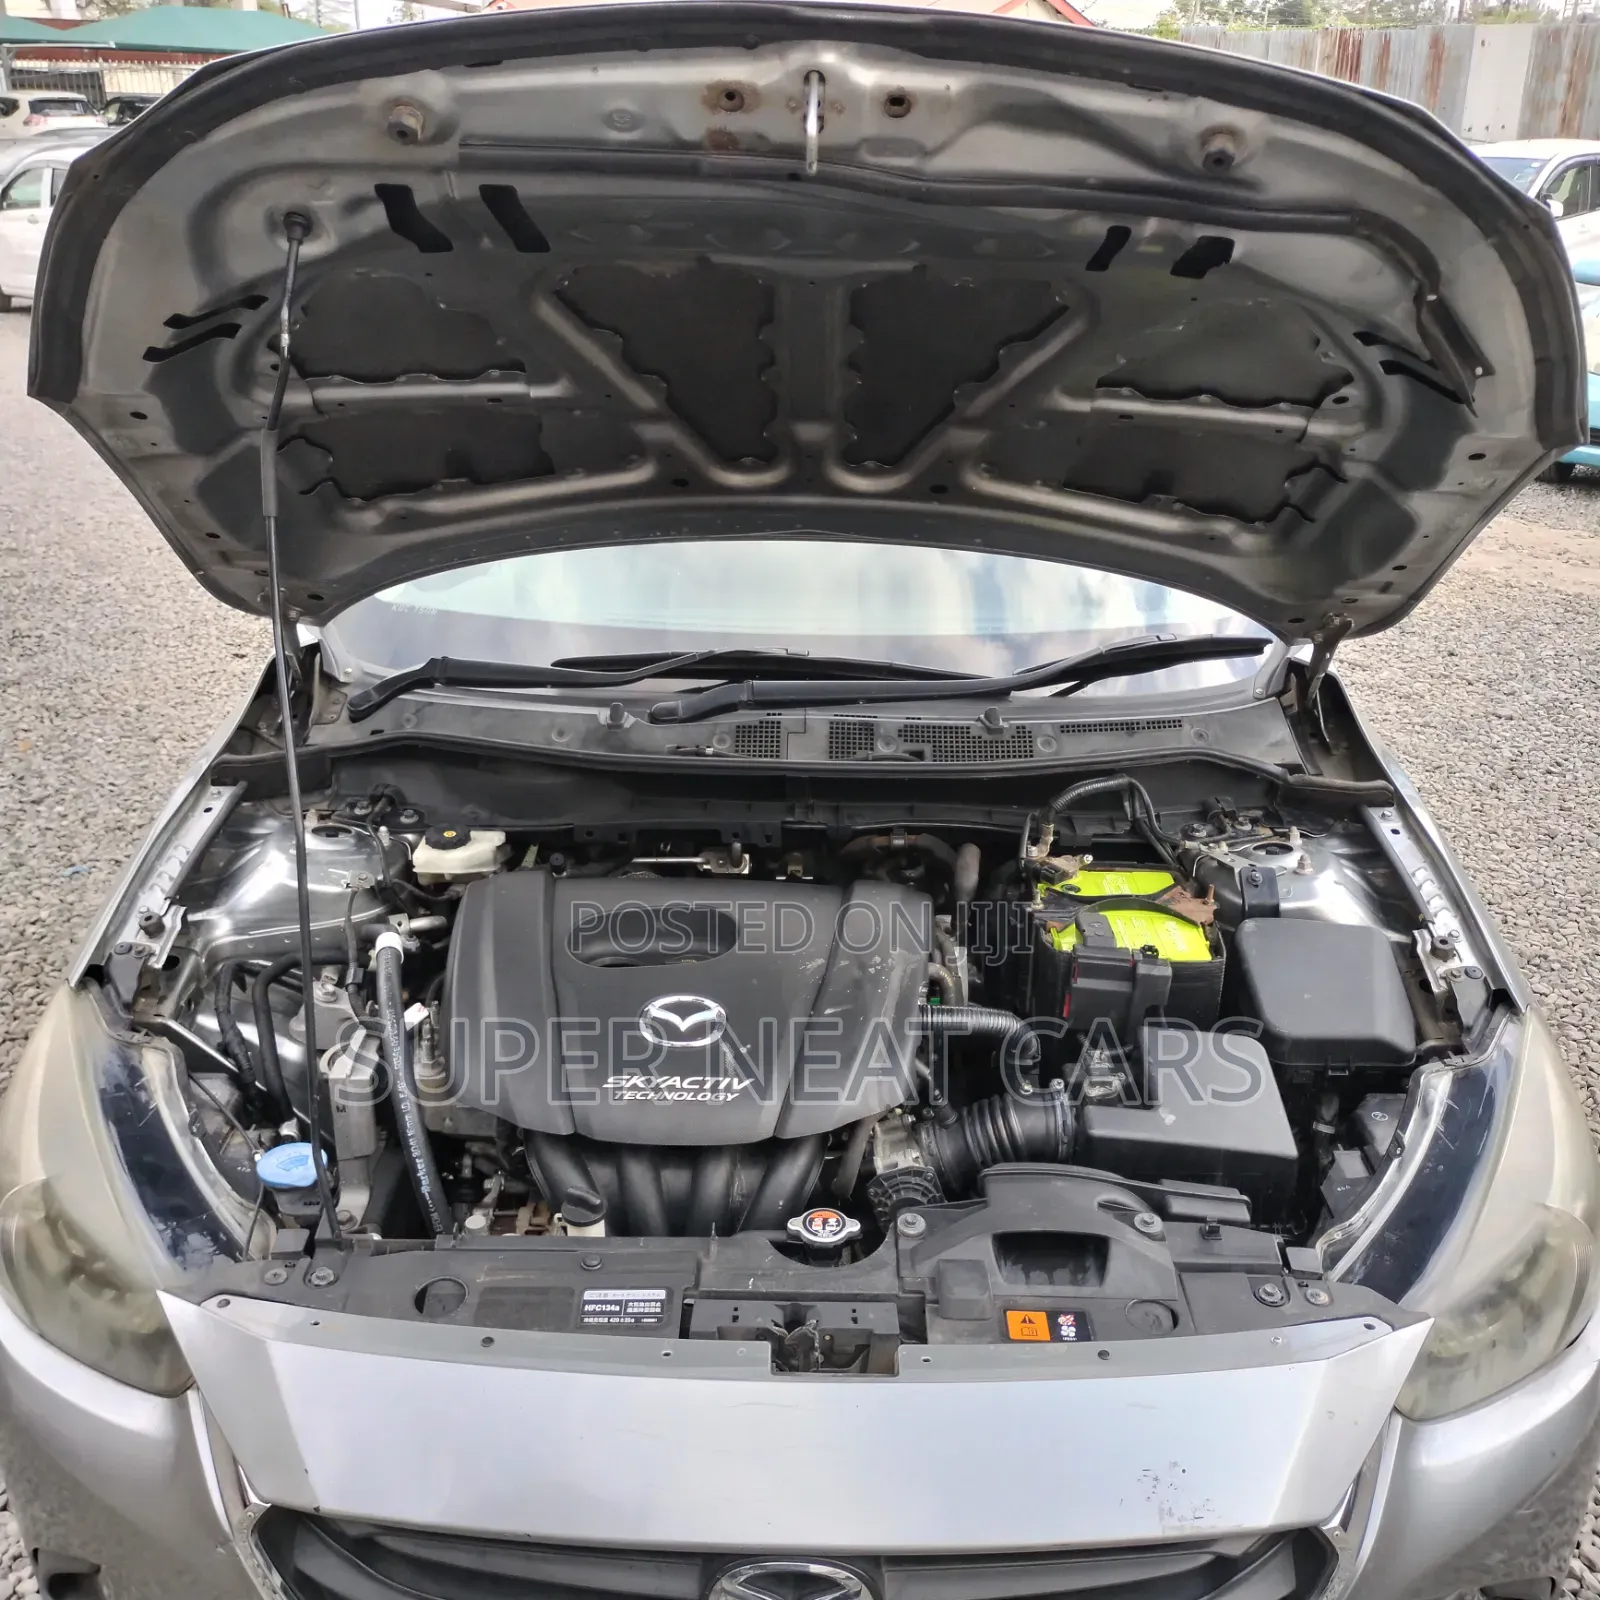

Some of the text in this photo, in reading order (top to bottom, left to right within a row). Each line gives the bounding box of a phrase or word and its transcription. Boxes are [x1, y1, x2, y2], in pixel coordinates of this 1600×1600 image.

[602, 1075, 755, 1090] SKYACTIV
[614, 1091, 740, 1101] TECHNOLOGY
[584, 1304, 620, 1312] HFC134a
